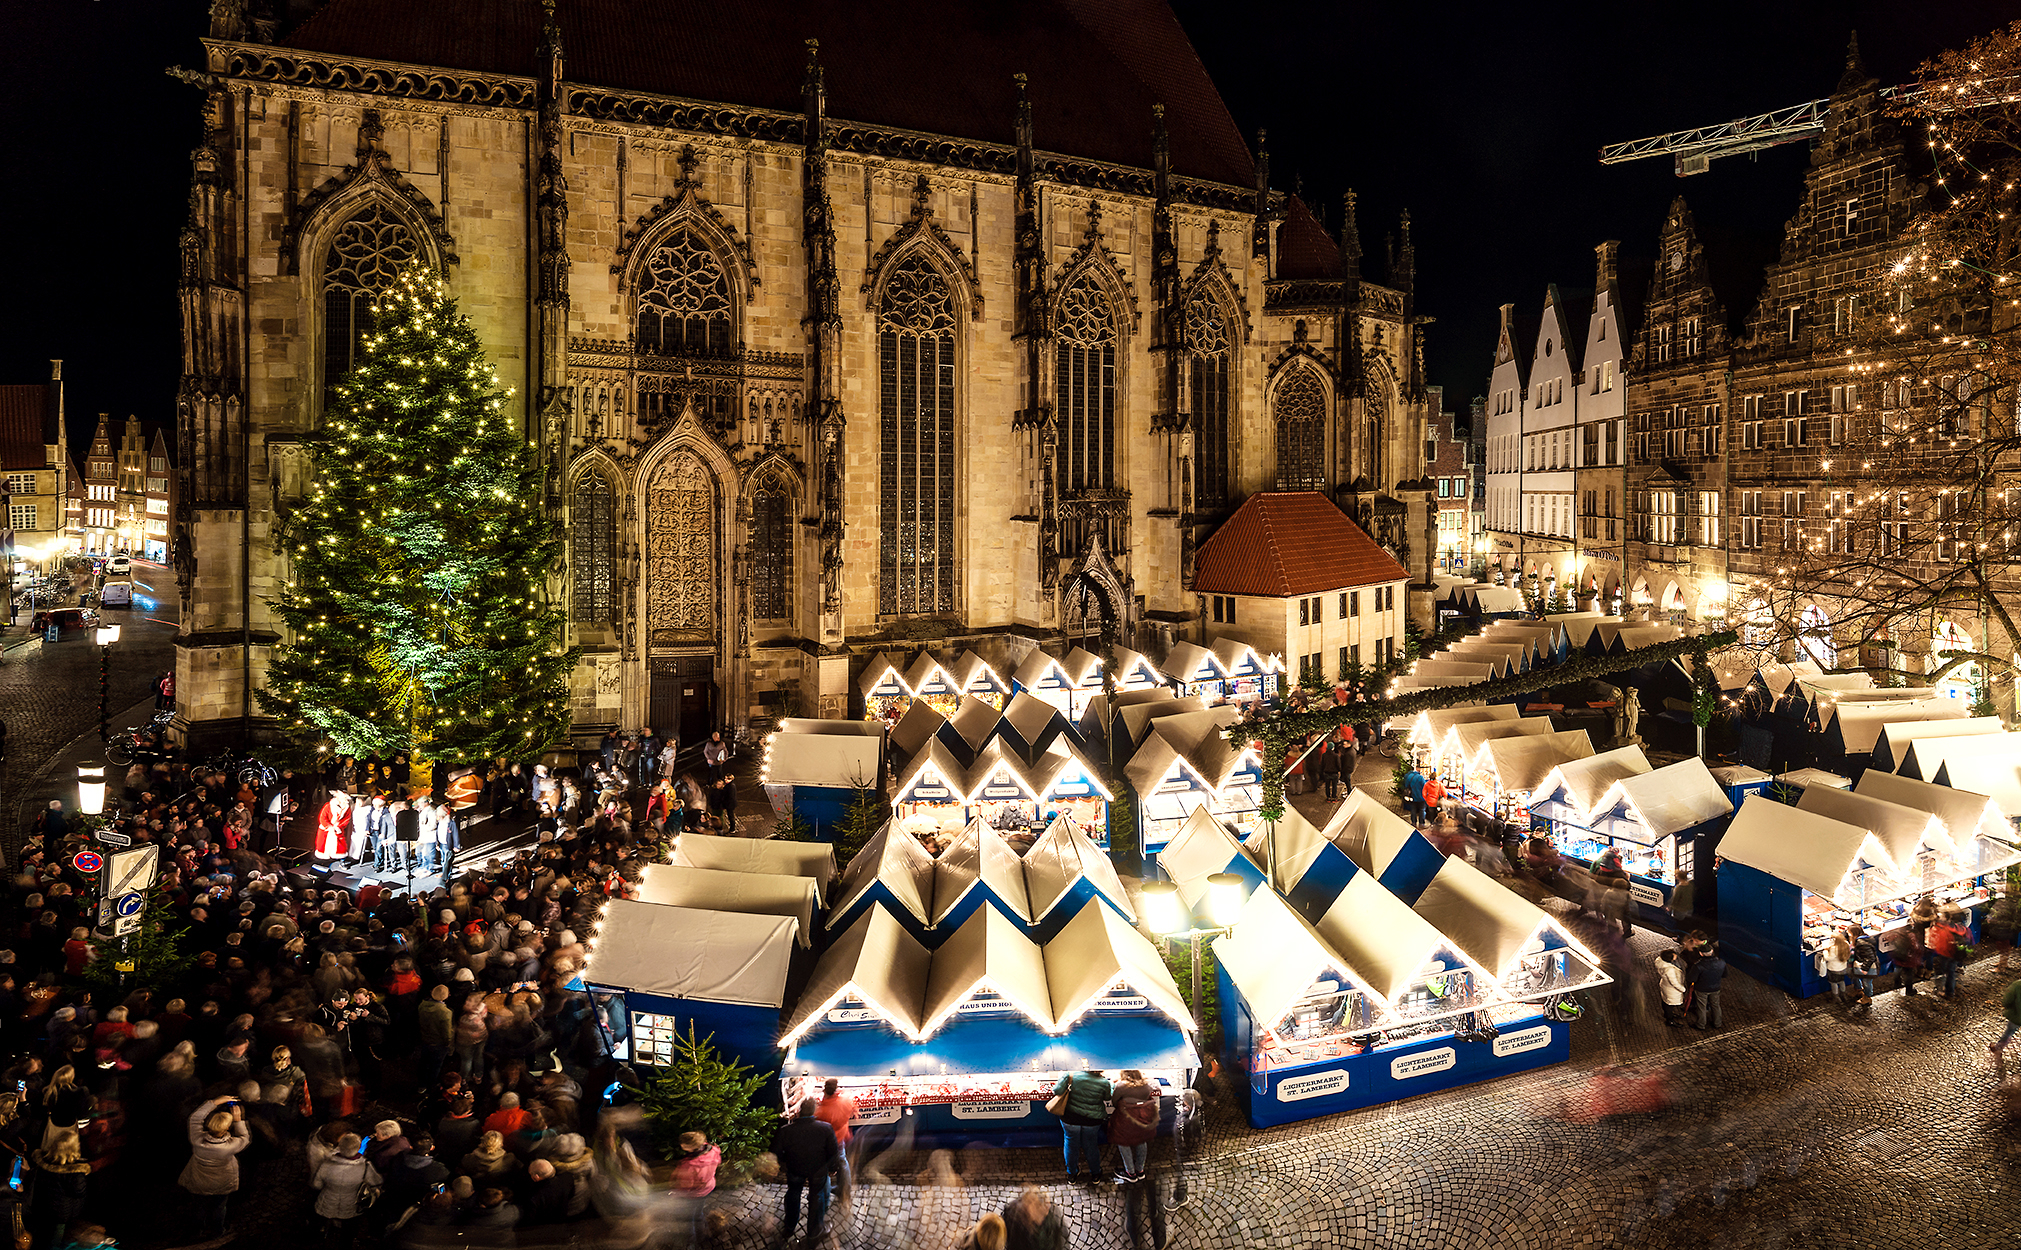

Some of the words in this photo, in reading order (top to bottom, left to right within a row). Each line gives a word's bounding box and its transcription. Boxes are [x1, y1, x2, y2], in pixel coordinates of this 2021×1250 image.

[1498, 1031, 1547, 1046] LICHTERMARKT
[1512, 1037, 1544, 1048] LAMBERTI
[1396, 1052, 1451, 1068] LICHTERMARKT
[1412, 1059, 1448, 1071] LAMBERTI
[1283, 1075, 1344, 1090] LICHTERMARKT
[1301, 1082, 1340, 1093] LAMBERTI
